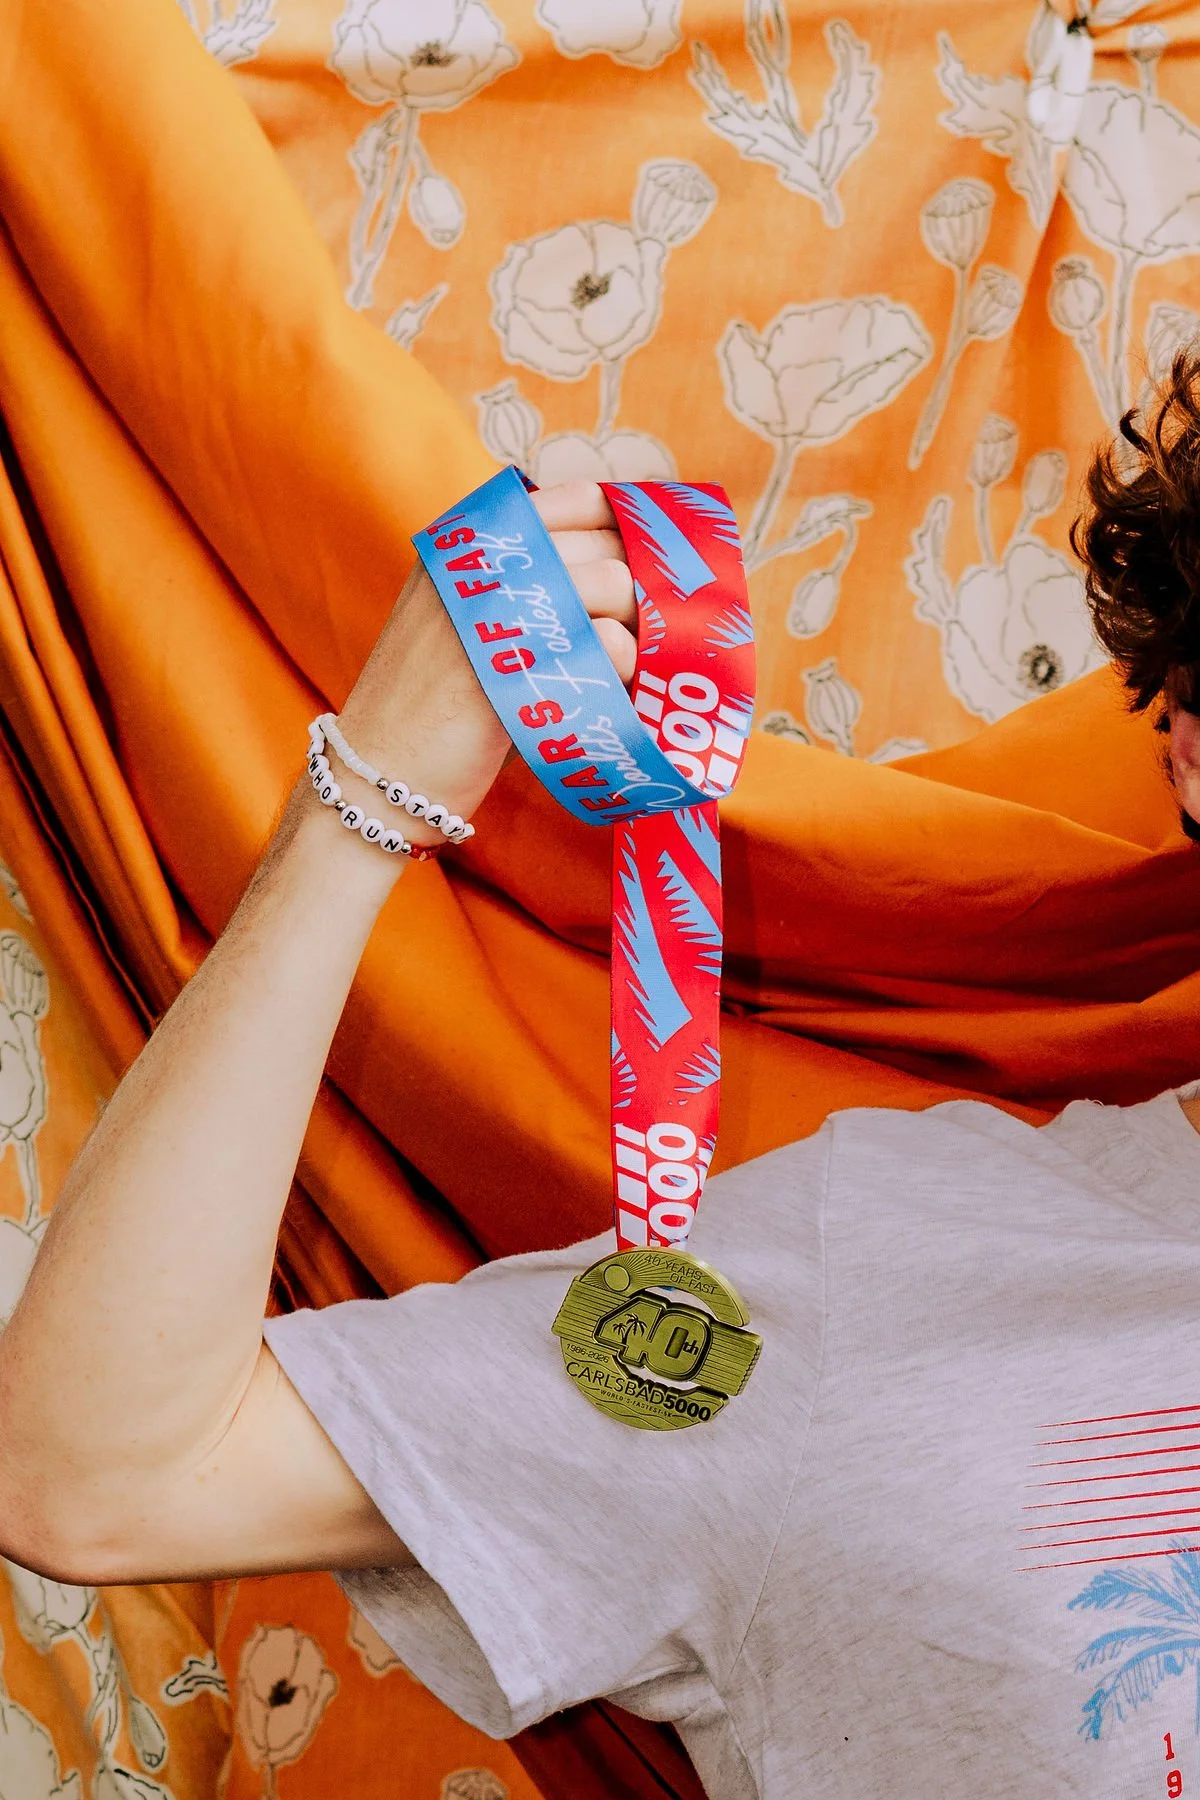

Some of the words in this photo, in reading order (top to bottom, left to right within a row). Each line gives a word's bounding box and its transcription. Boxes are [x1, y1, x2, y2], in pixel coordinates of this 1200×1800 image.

[471, 532, 533, 575] 5K
[474, 620, 536, 676] OF
[498, 584, 610, 720] Fastest
[661, 671, 719, 790] 000
[309, 756, 332, 800] WHO
[344, 811, 399, 851] RUN
[646, 1122, 699, 1246] 000
[643, 1254, 661, 1267] 40
[664, 1261, 702, 1281] YEARS
[670, 1272, 686, 1287] OF
[688, 1275, 718, 1295] FAST
[566, 1361, 712, 1422] CARLSBAD5000
